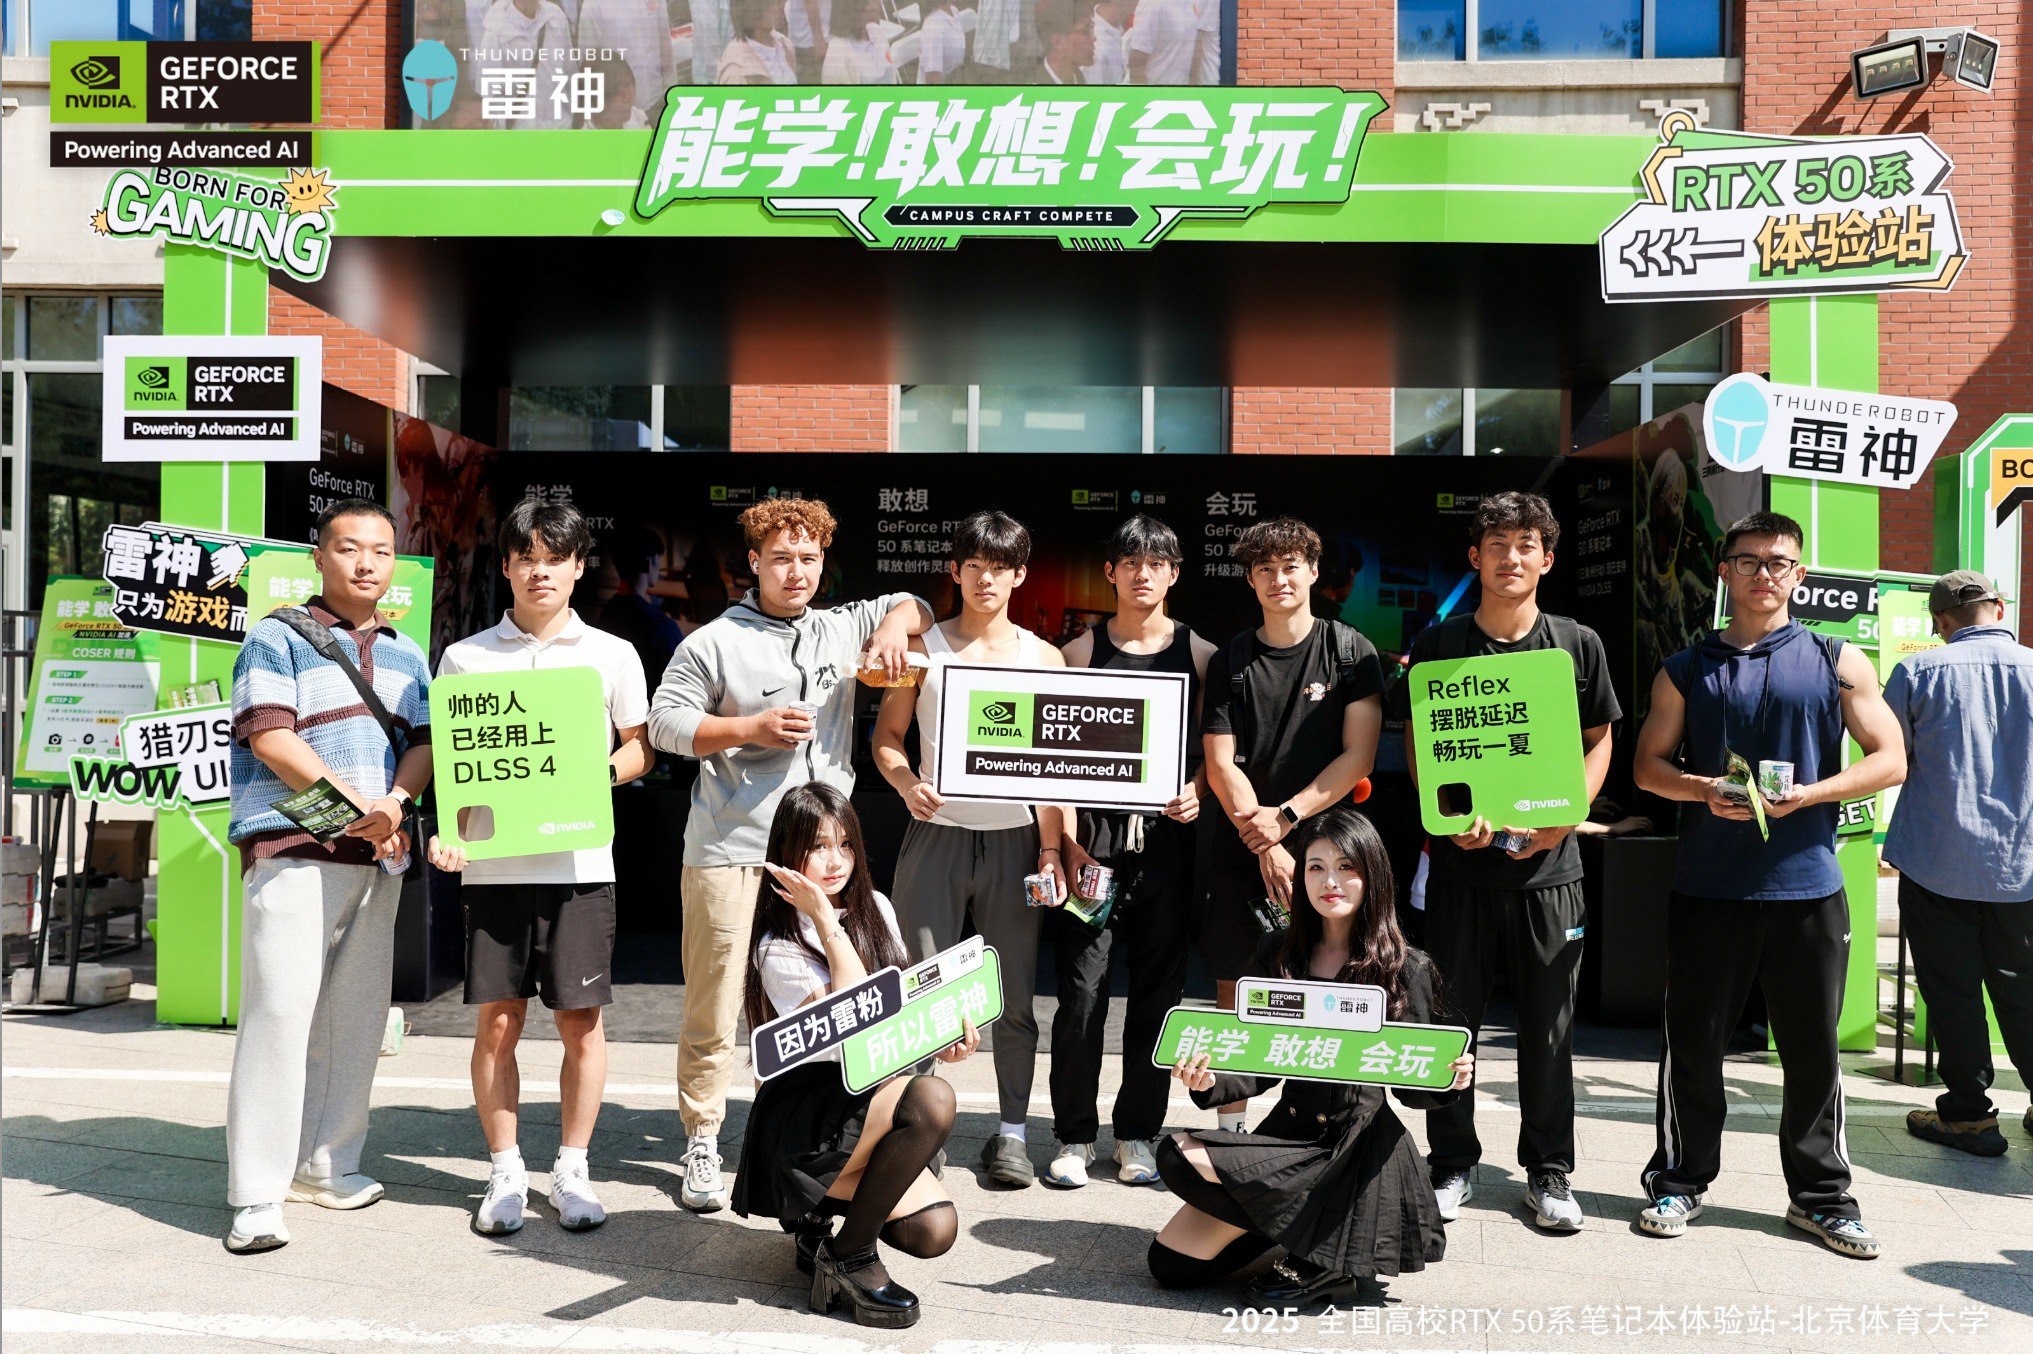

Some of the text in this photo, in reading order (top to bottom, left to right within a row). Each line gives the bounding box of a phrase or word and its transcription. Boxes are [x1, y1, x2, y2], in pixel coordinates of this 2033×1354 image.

[154, 167, 286, 211] BORN FOR
[1672, 149, 1915, 213] RTX 50系
[106, 171, 327, 277] GAMING
[909, 210, 1114, 222] CAMPUS CRAFT COMPETE
[1753, 204, 1935, 278] 体验站
[194, 365, 286, 383] GEFORCE
[133, 391, 177, 401] NVIDIA
[194, 385, 234, 402] RTX
[1773, 394, 1946, 425] THUNDEROBOT
[132, 421, 285, 438] Powering Advanced AI
[1788, 416, 1918, 481] 雷神
[309, 467, 375, 500] GeForce RTX
[878, 488, 929, 513] 敢想
[1205, 491, 1257, 516] 会玩
[586, 517, 615, 530] RTX
[877, 520, 938, 533] GeForce
[106, 527, 202, 588] 雷神
[877, 539, 953, 554] 50 系笔记本
[1204, 544, 1223, 557] 50
[1204, 563, 1248, 577] 升级游
[268, 576, 314, 599] 能学
[56, 599, 114, 618] 能学 敢
[114, 588, 248, 632] 只为游戏而
[64, 622, 94, 630] GeForce
[96, 622, 110, 630] RTX
[72, 648, 112, 659] COSER
[1427, 675, 1511, 701] Reflex
[448, 690, 527, 719] 帅的人
[1041, 703, 1135, 725] GEFORCE
[1430, 701, 1530, 732] 摆脱延迟
[451, 721, 556, 751] 已经用上
[977, 726, 1023, 738] NVIDIA
[1041, 724, 1082, 742] RTX
[1432, 732, 1533, 763] 畅玩一夏
[453, 755, 557, 784] DLSS 4
[975, 756, 1133, 777] Powering Advanced AI
[74, 760, 182, 800] WOW
[1532, 798, 1571, 810] NVIDIA
[556, 821, 596, 833] NVIDIA
[1270, 993, 1301, 1002] GEFORCE
[1340, 1001, 1368, 1014] 雷神
[773, 984, 885, 1063] 因为雷粉
[1249, 1009, 1272, 1017] Powering
[865, 980, 989, 1073] 所以雷神
[1174, 1025, 1437, 1079] 能学 敢想 会玩
